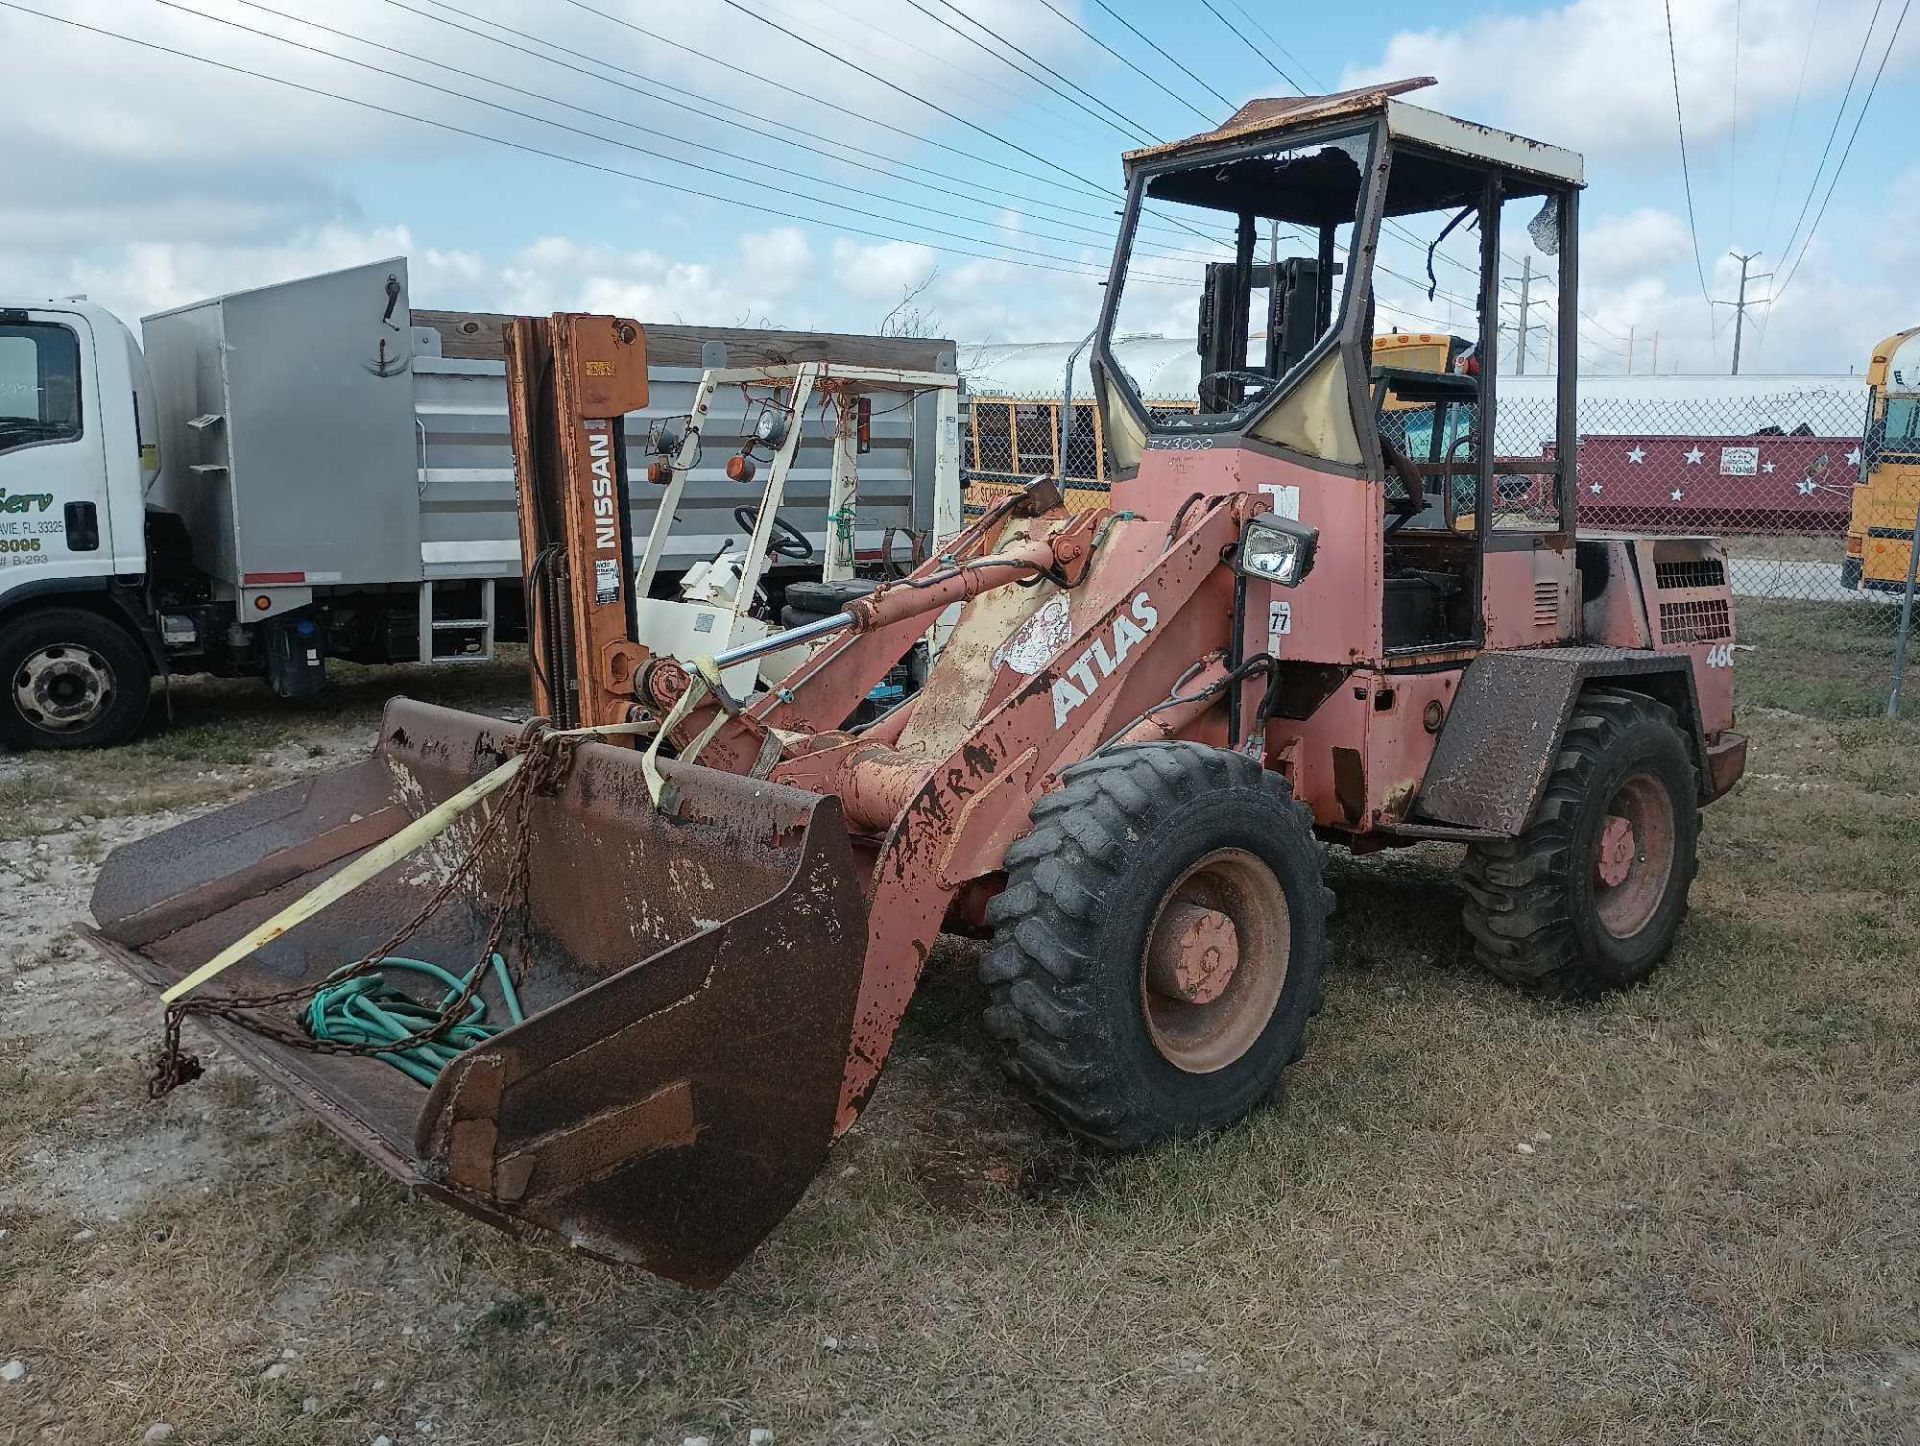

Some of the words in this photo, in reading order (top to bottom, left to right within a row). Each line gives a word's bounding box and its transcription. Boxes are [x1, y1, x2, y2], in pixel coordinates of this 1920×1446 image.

[588, 434, 616, 548] NISSAN
[38, 520, 64, 534] 33325
[12, 554, 49, 566] B-293
[1271, 613, 1288, 631] 77
[1051, 592, 1158, 730] ATLAS
